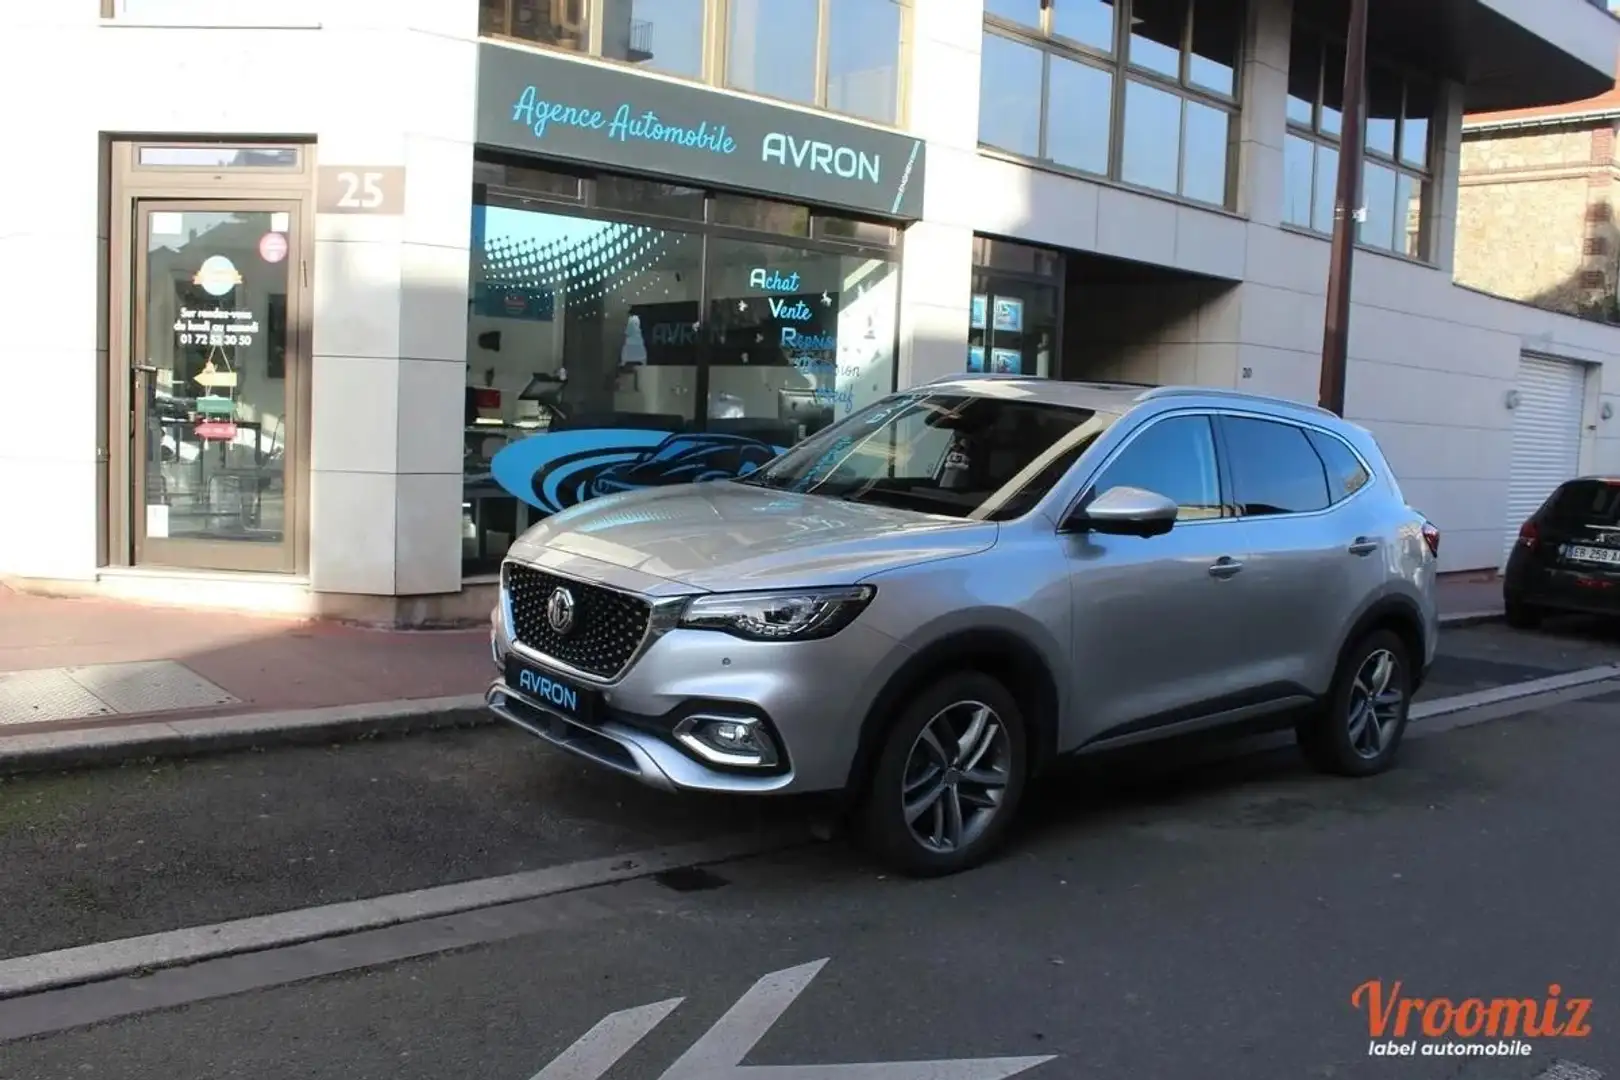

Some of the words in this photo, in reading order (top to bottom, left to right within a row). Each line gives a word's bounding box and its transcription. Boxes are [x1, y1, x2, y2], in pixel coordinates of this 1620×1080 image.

[512, 85, 606, 137] Agence
[608, 103, 738, 154] Automobile
[761, 132, 881, 184] AVRON
[336, 171, 384, 208] 25
[750, 268, 800, 292] Achat
[768, 297, 812, 320] Vente
[180, 333, 193, 345] 01
[195, 333, 208, 345] 72
[520, 669, 577, 711] AVRON
